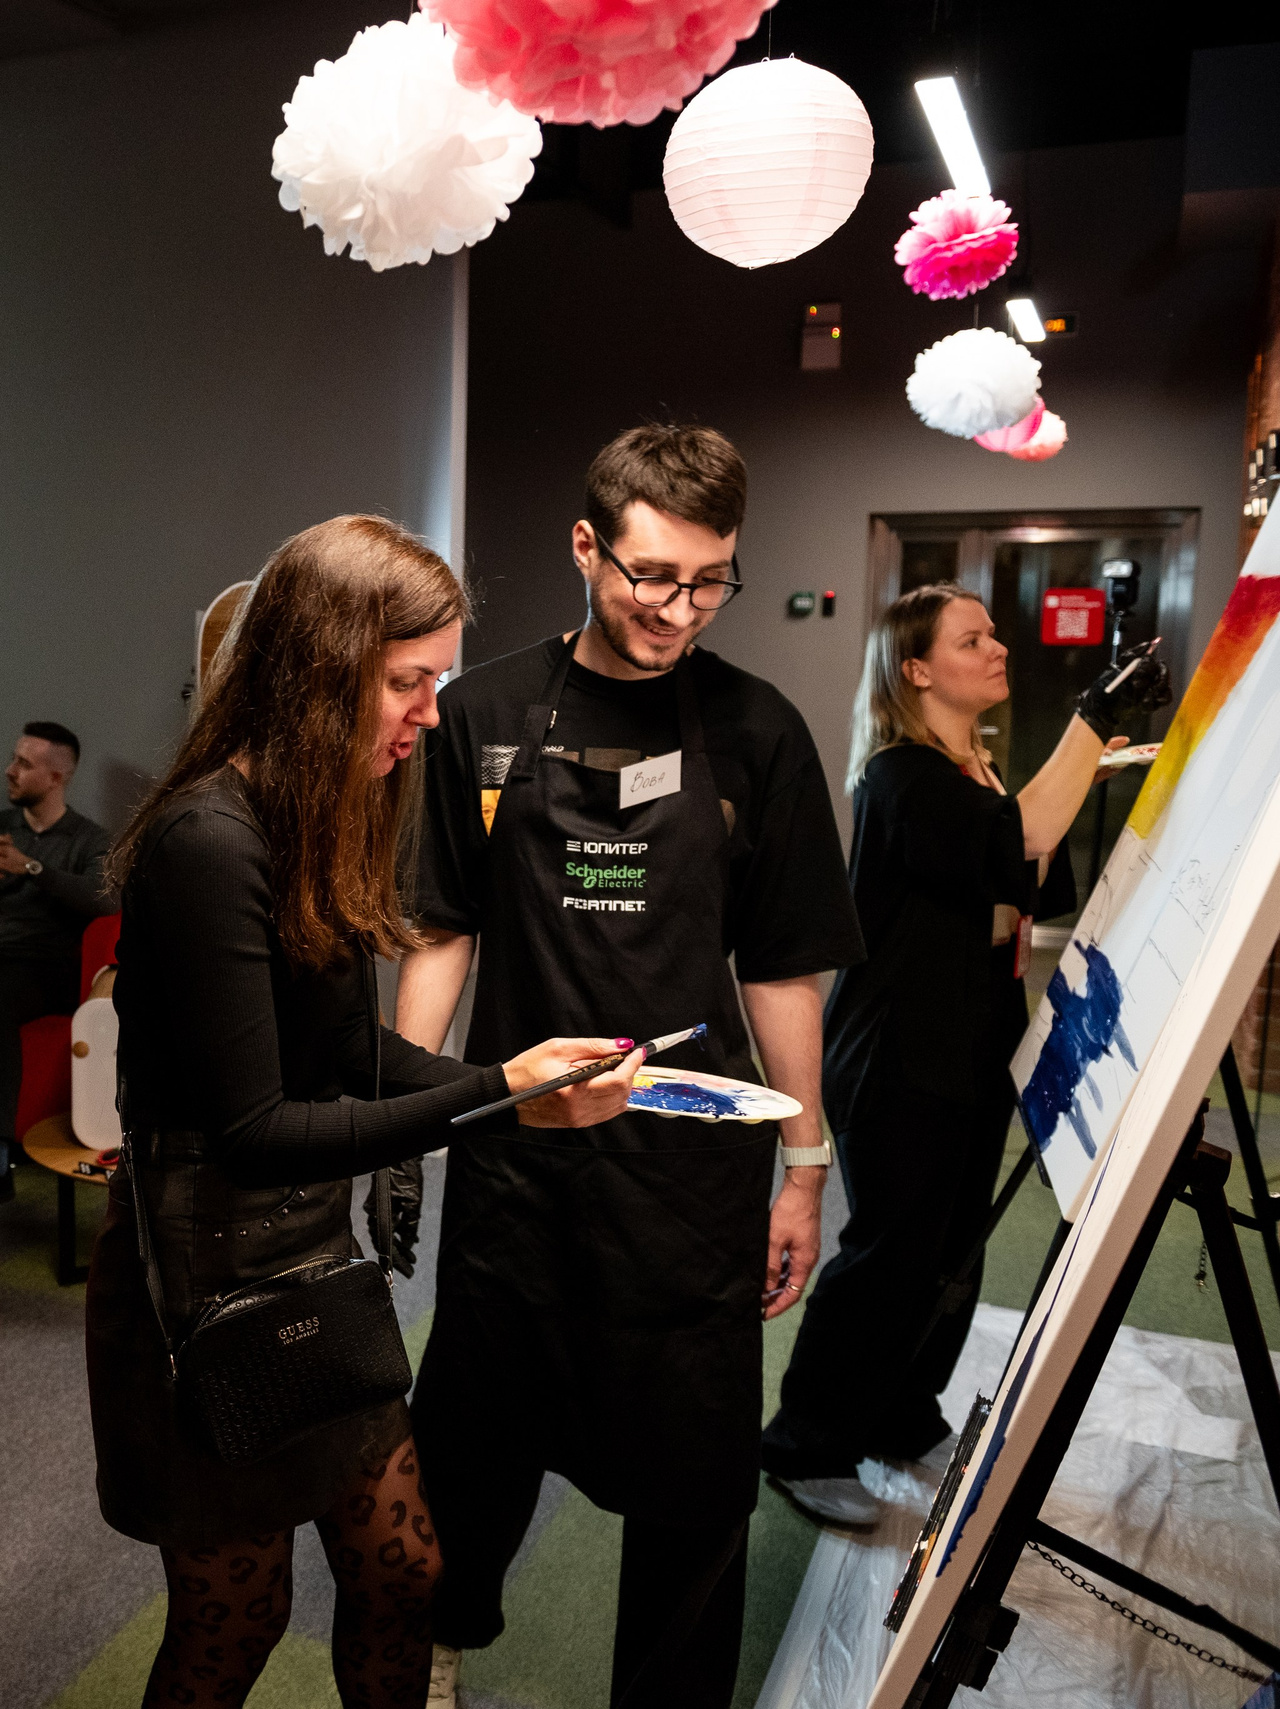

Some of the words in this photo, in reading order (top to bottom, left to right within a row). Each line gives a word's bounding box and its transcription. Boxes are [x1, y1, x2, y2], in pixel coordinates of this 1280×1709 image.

[583, 841, 648, 855] ЮПИТЕР
[566, 862, 646, 879] Schneider
[598, 879, 644, 888] Electric
[278, 1316, 320, 1340] GUESS
